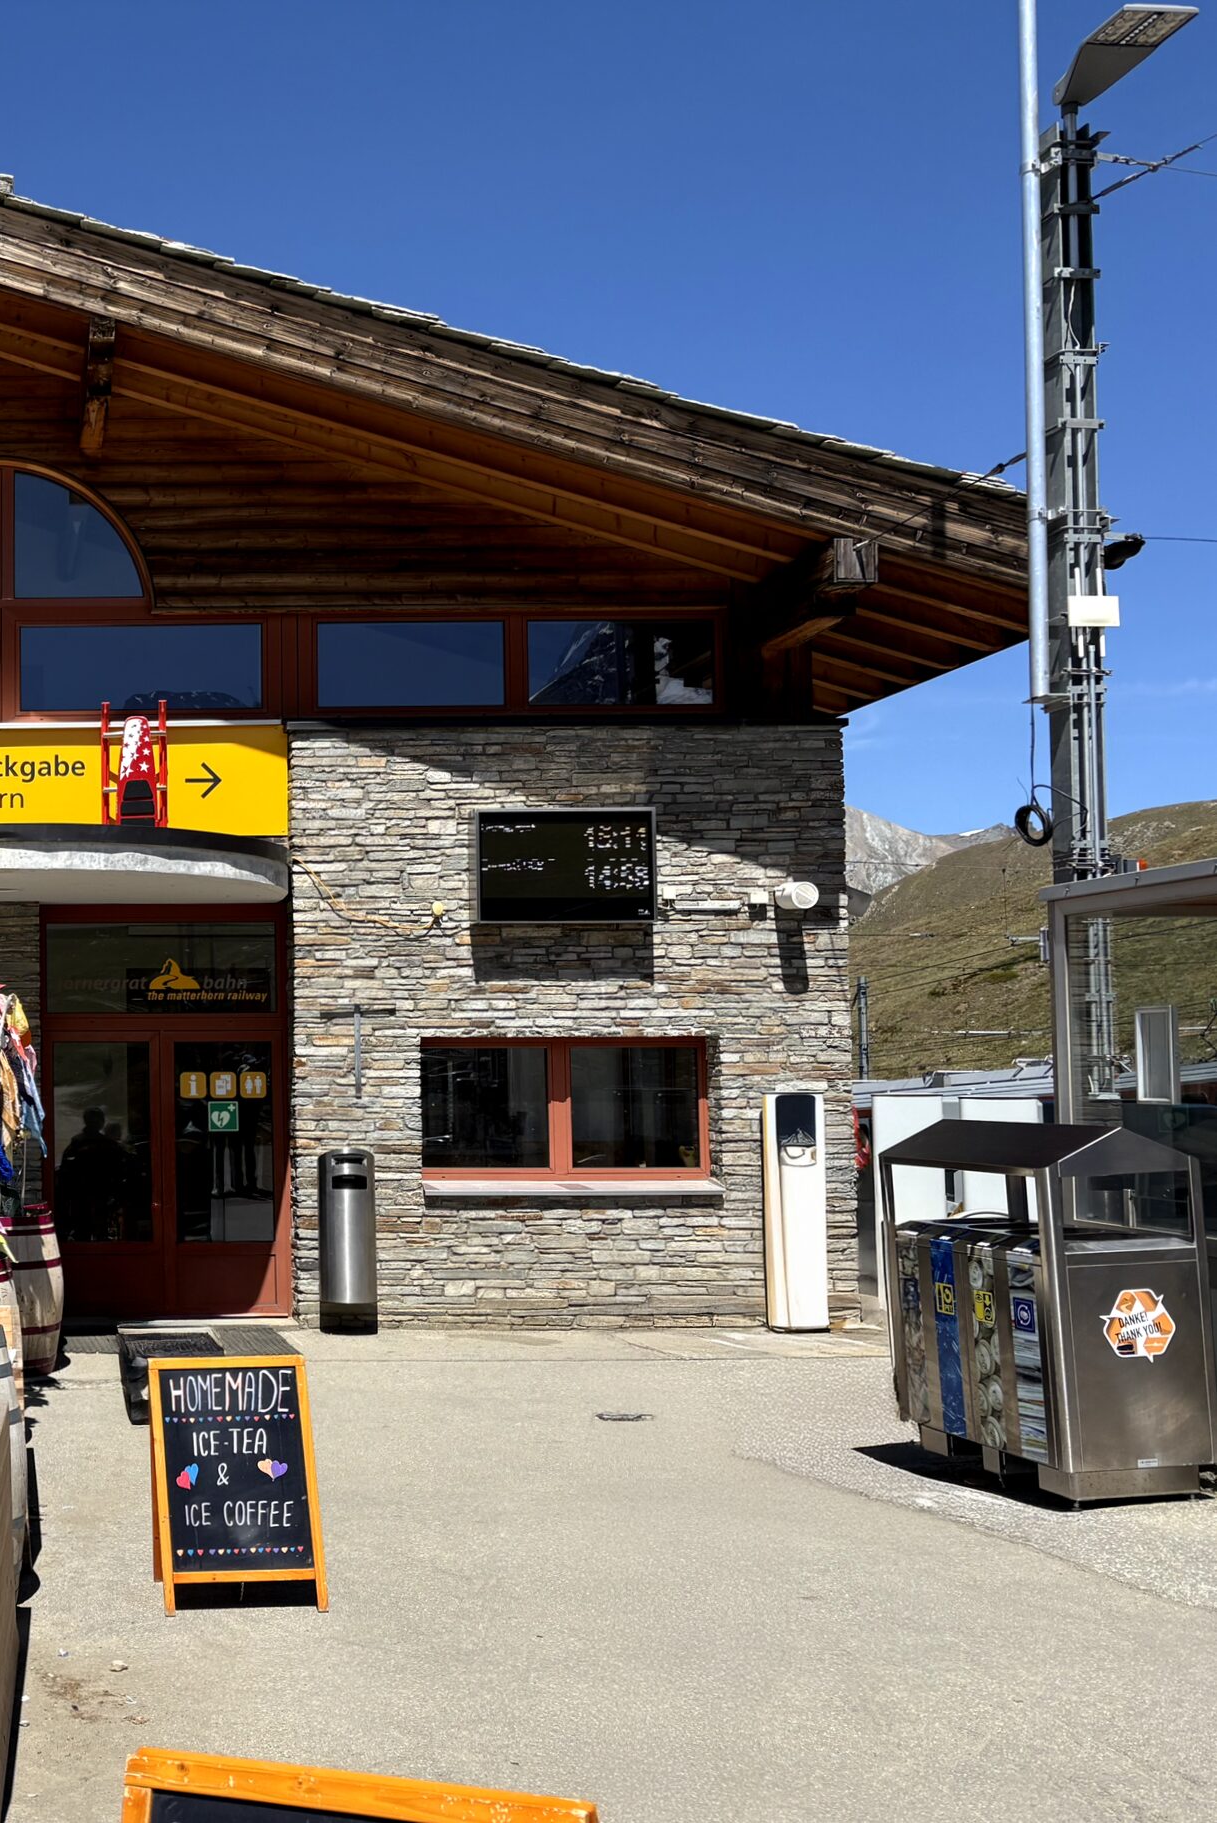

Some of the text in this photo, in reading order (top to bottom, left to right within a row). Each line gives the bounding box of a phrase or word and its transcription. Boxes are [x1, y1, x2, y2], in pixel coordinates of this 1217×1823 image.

[202, 974, 248, 990] bahn
[147, 990, 268, 1003] the matterhorn railway
[1118, 1311, 1149, 1329] DANKE!
[1115, 1321, 1163, 1344] THANK YOU!
[169, 1369, 293, 1413] HOMEMADE
[216, 1462, 230, 1487] &
[184, 1500, 295, 1528] ICE COFFEE
